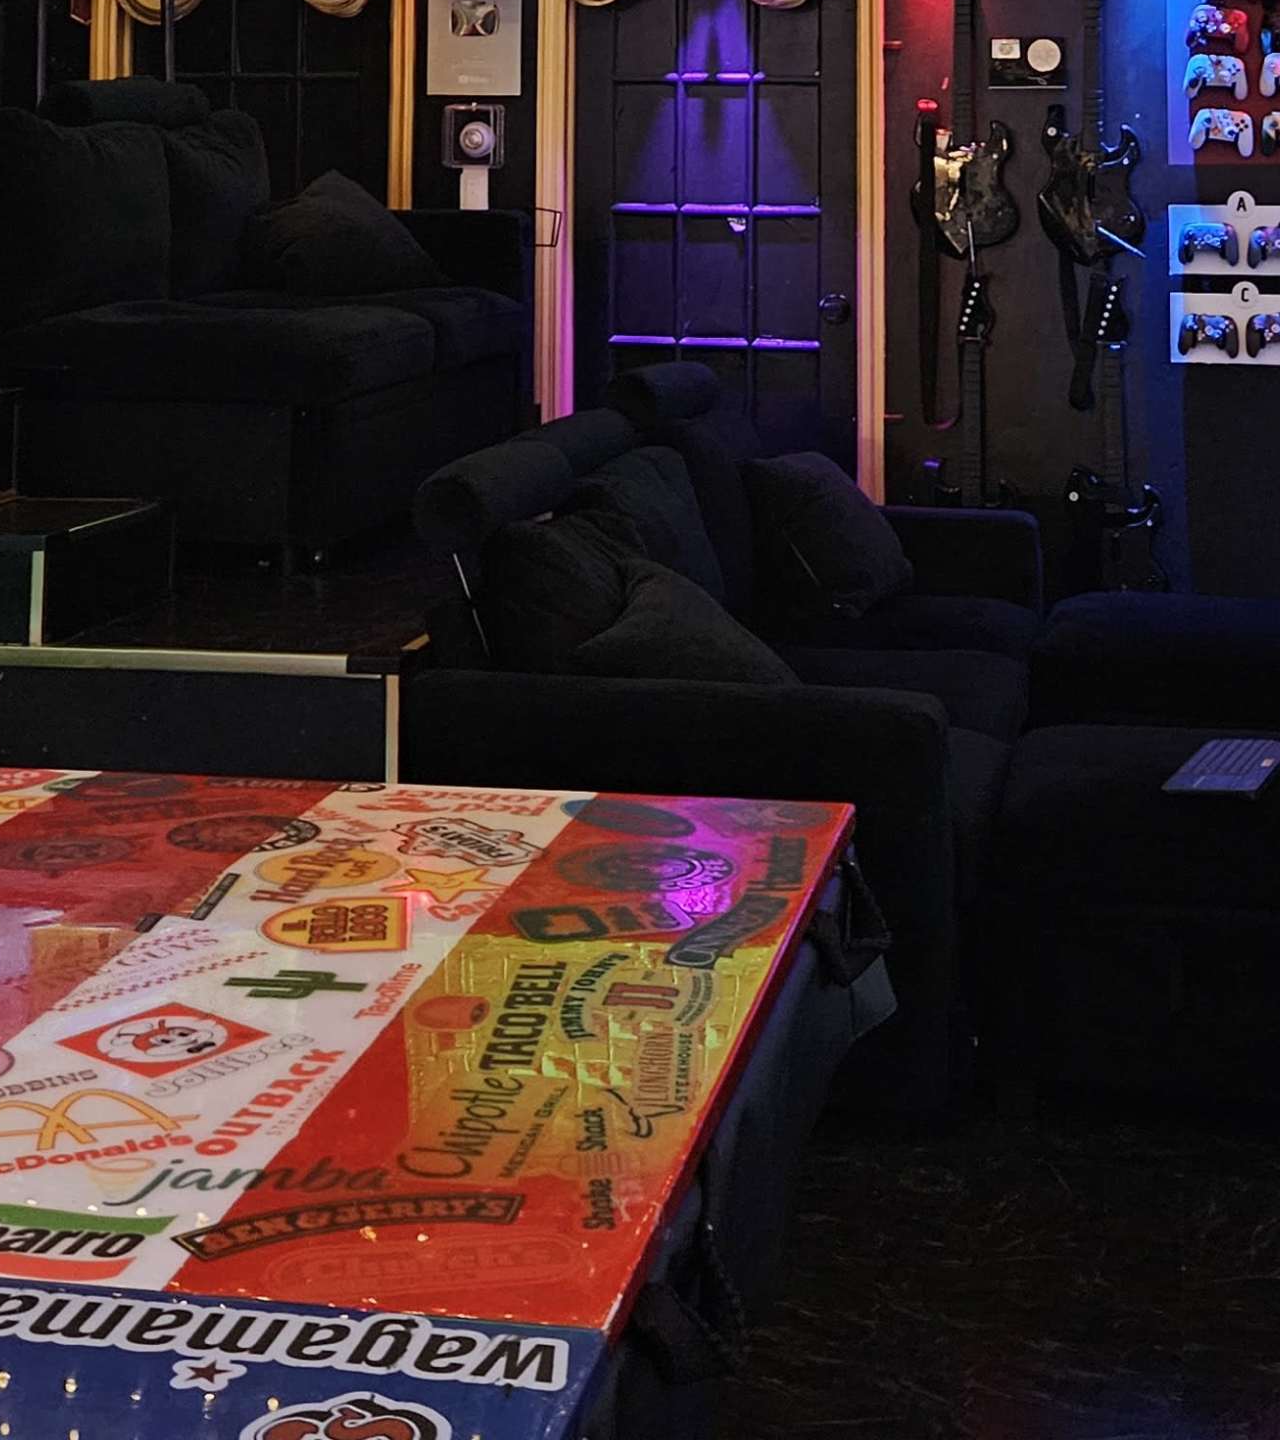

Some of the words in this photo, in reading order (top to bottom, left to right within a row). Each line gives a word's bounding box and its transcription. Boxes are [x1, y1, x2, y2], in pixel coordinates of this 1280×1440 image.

[1235, 196, 1248, 215] A
[1239, 287, 1251, 304] C
[250, 867, 318, 904] Hard
[503, 961, 568, 1012] BELL
[479, 1011, 549, 1071] TACO
[674, 1031, 694, 1103] STEAKHOUSE
[195, 1047, 346, 1159] OUTBACK
[397, 1074, 525, 1179] Chipotle
[576, 1106, 609, 1154] Shack
[497, 1120, 545, 1179] MEXICAN
[533, 1085, 569, 1120] GRILL
[102, 1157, 391, 1207] jamba
[582, 1176, 617, 1231] Shake
[201, 1213, 292, 1256] BEN
[332, 1195, 509, 1225] JERRY'S
